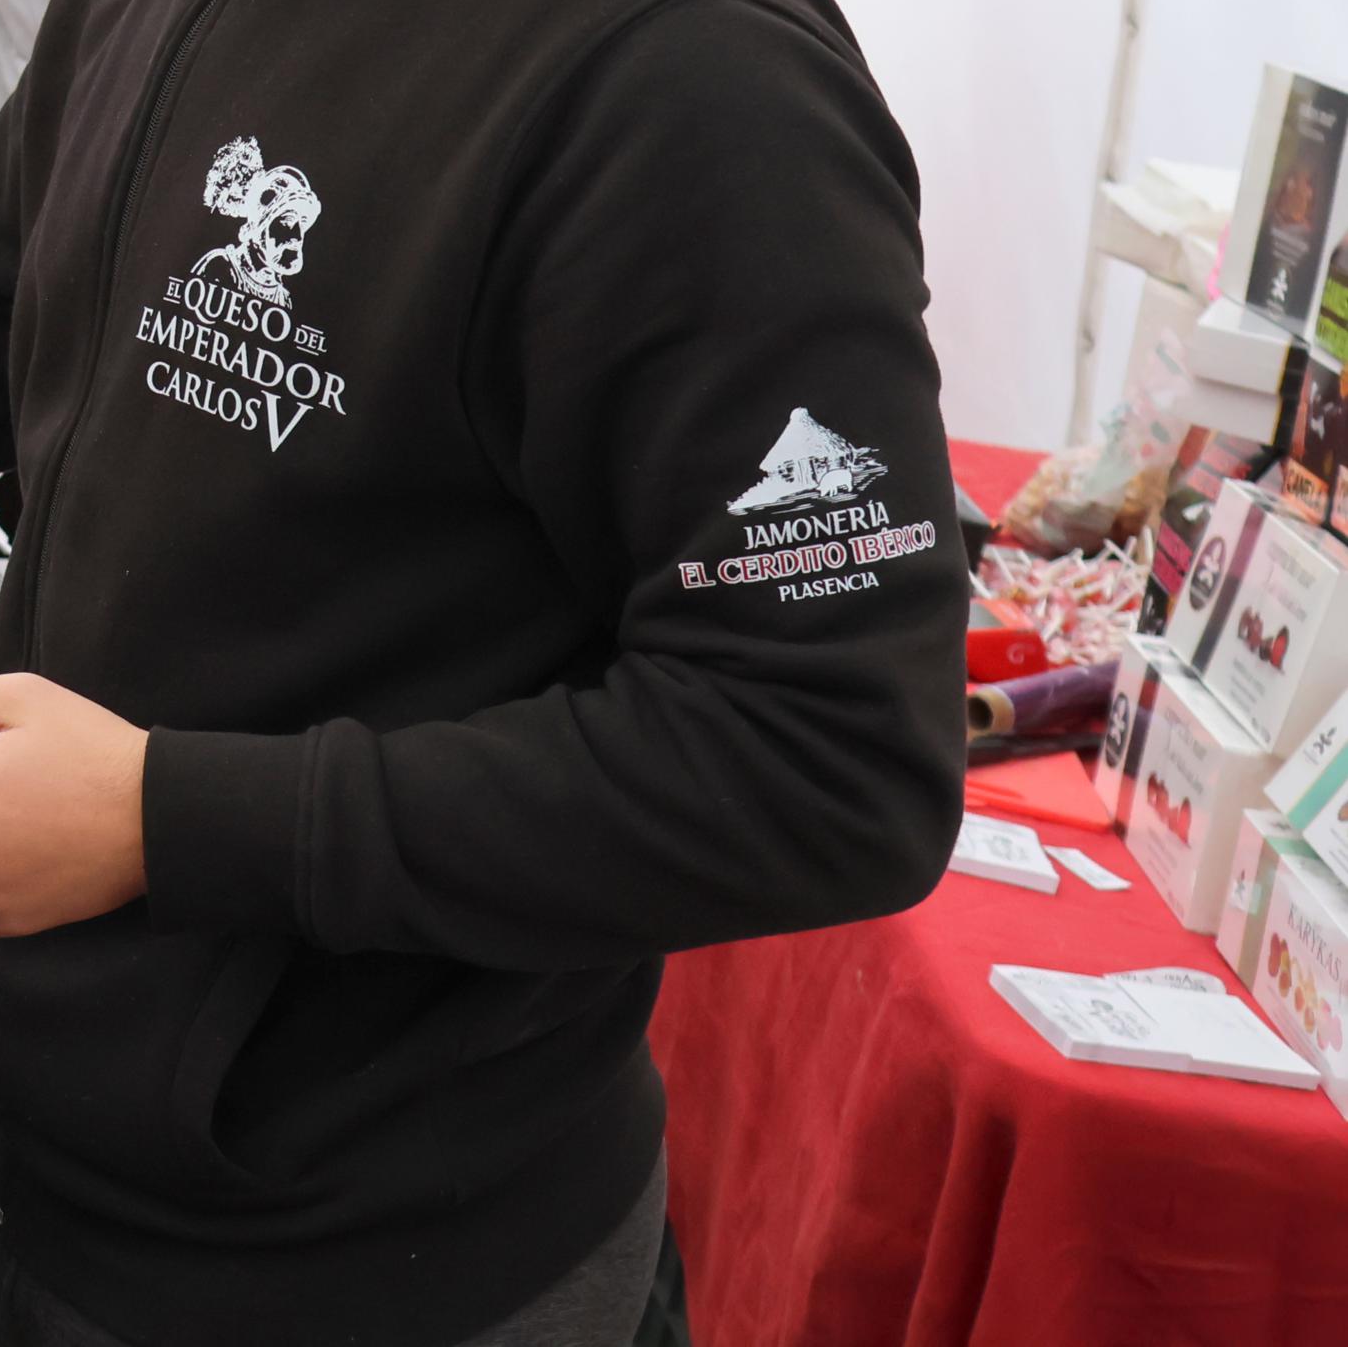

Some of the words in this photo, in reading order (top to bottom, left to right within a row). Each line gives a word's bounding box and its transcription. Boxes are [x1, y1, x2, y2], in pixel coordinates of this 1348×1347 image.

[166, 281, 182, 299] EL
[184, 277, 292, 342] QUESO
[294, 327, 328, 353] DEL
[135, 306, 347, 416] EMPERADOR
[146, 361, 262, 431] CARLOS
[260, 389, 314, 453] V
[678, 561, 717, 590] EL
[717, 541, 847, 585] CERDITO
[847, 520, 936, 566] IBÉRICO
[743, 500, 890, 550] JAMONERÍA
[777, 571, 880, 603] PLASENCIA
[1286, 903, 1343, 983] KARYKAS
